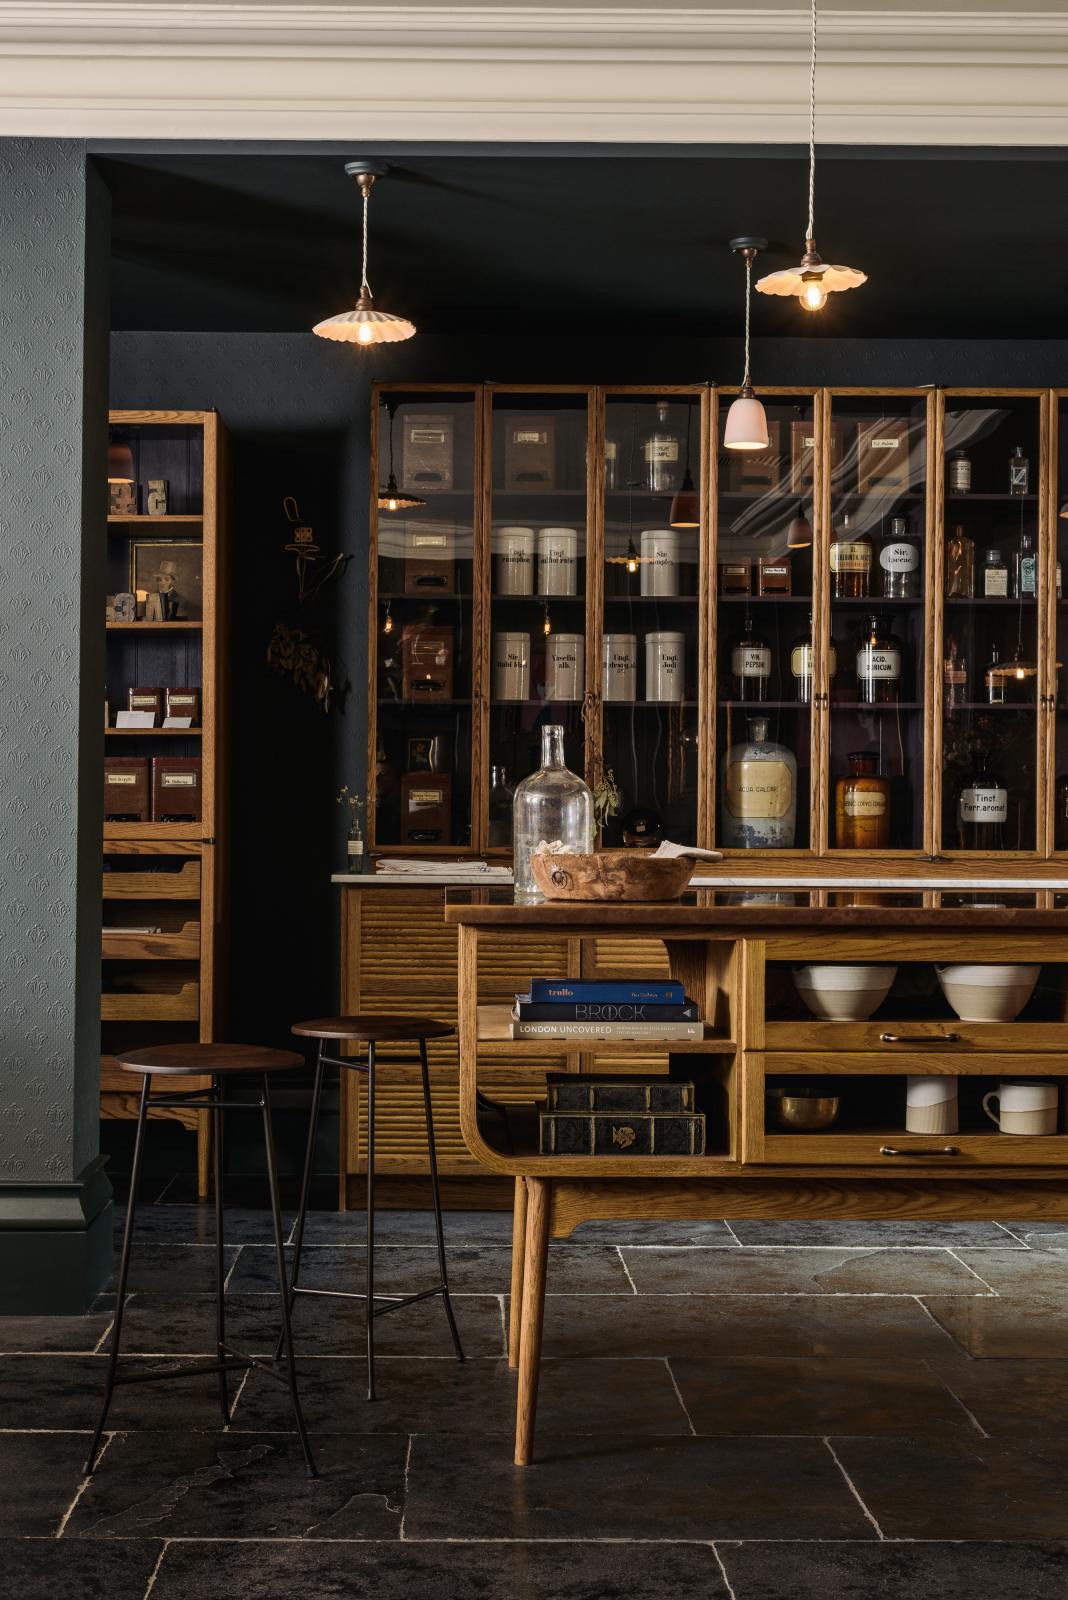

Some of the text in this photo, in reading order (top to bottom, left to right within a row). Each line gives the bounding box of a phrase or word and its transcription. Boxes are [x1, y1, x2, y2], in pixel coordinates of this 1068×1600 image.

[575, 1004, 646, 1021] BROCK
[519, 1025, 557, 1034] LONDON
[559, 1025, 612, 1034] UNCOVERED
